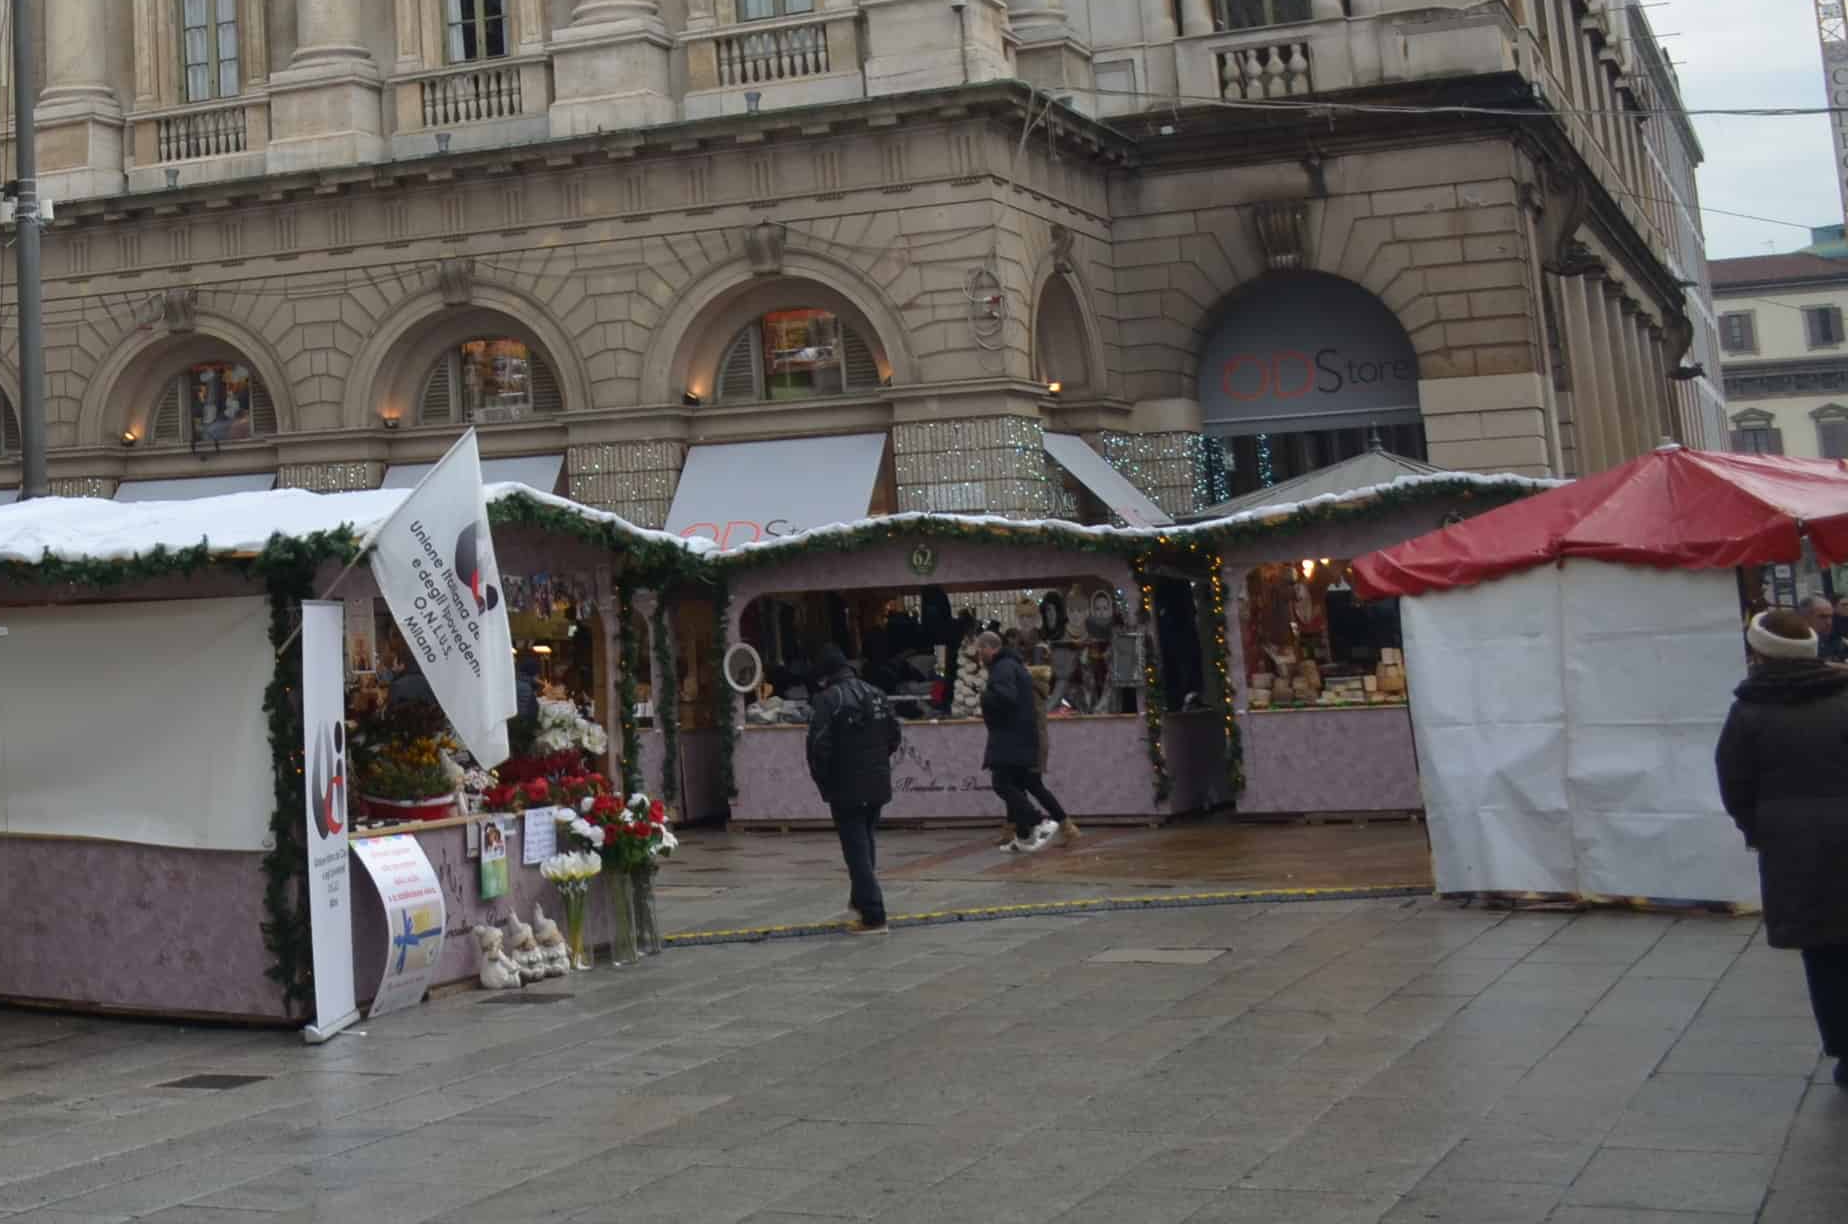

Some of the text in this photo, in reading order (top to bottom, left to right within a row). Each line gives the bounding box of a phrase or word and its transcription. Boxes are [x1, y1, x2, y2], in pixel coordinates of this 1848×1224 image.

[409, 520, 443, 569] Unione
[912, 548, 932, 567] 62
[412, 558, 422, 569] e
[418, 570, 448, 606] degli
[403, 615, 437, 664] Milano
